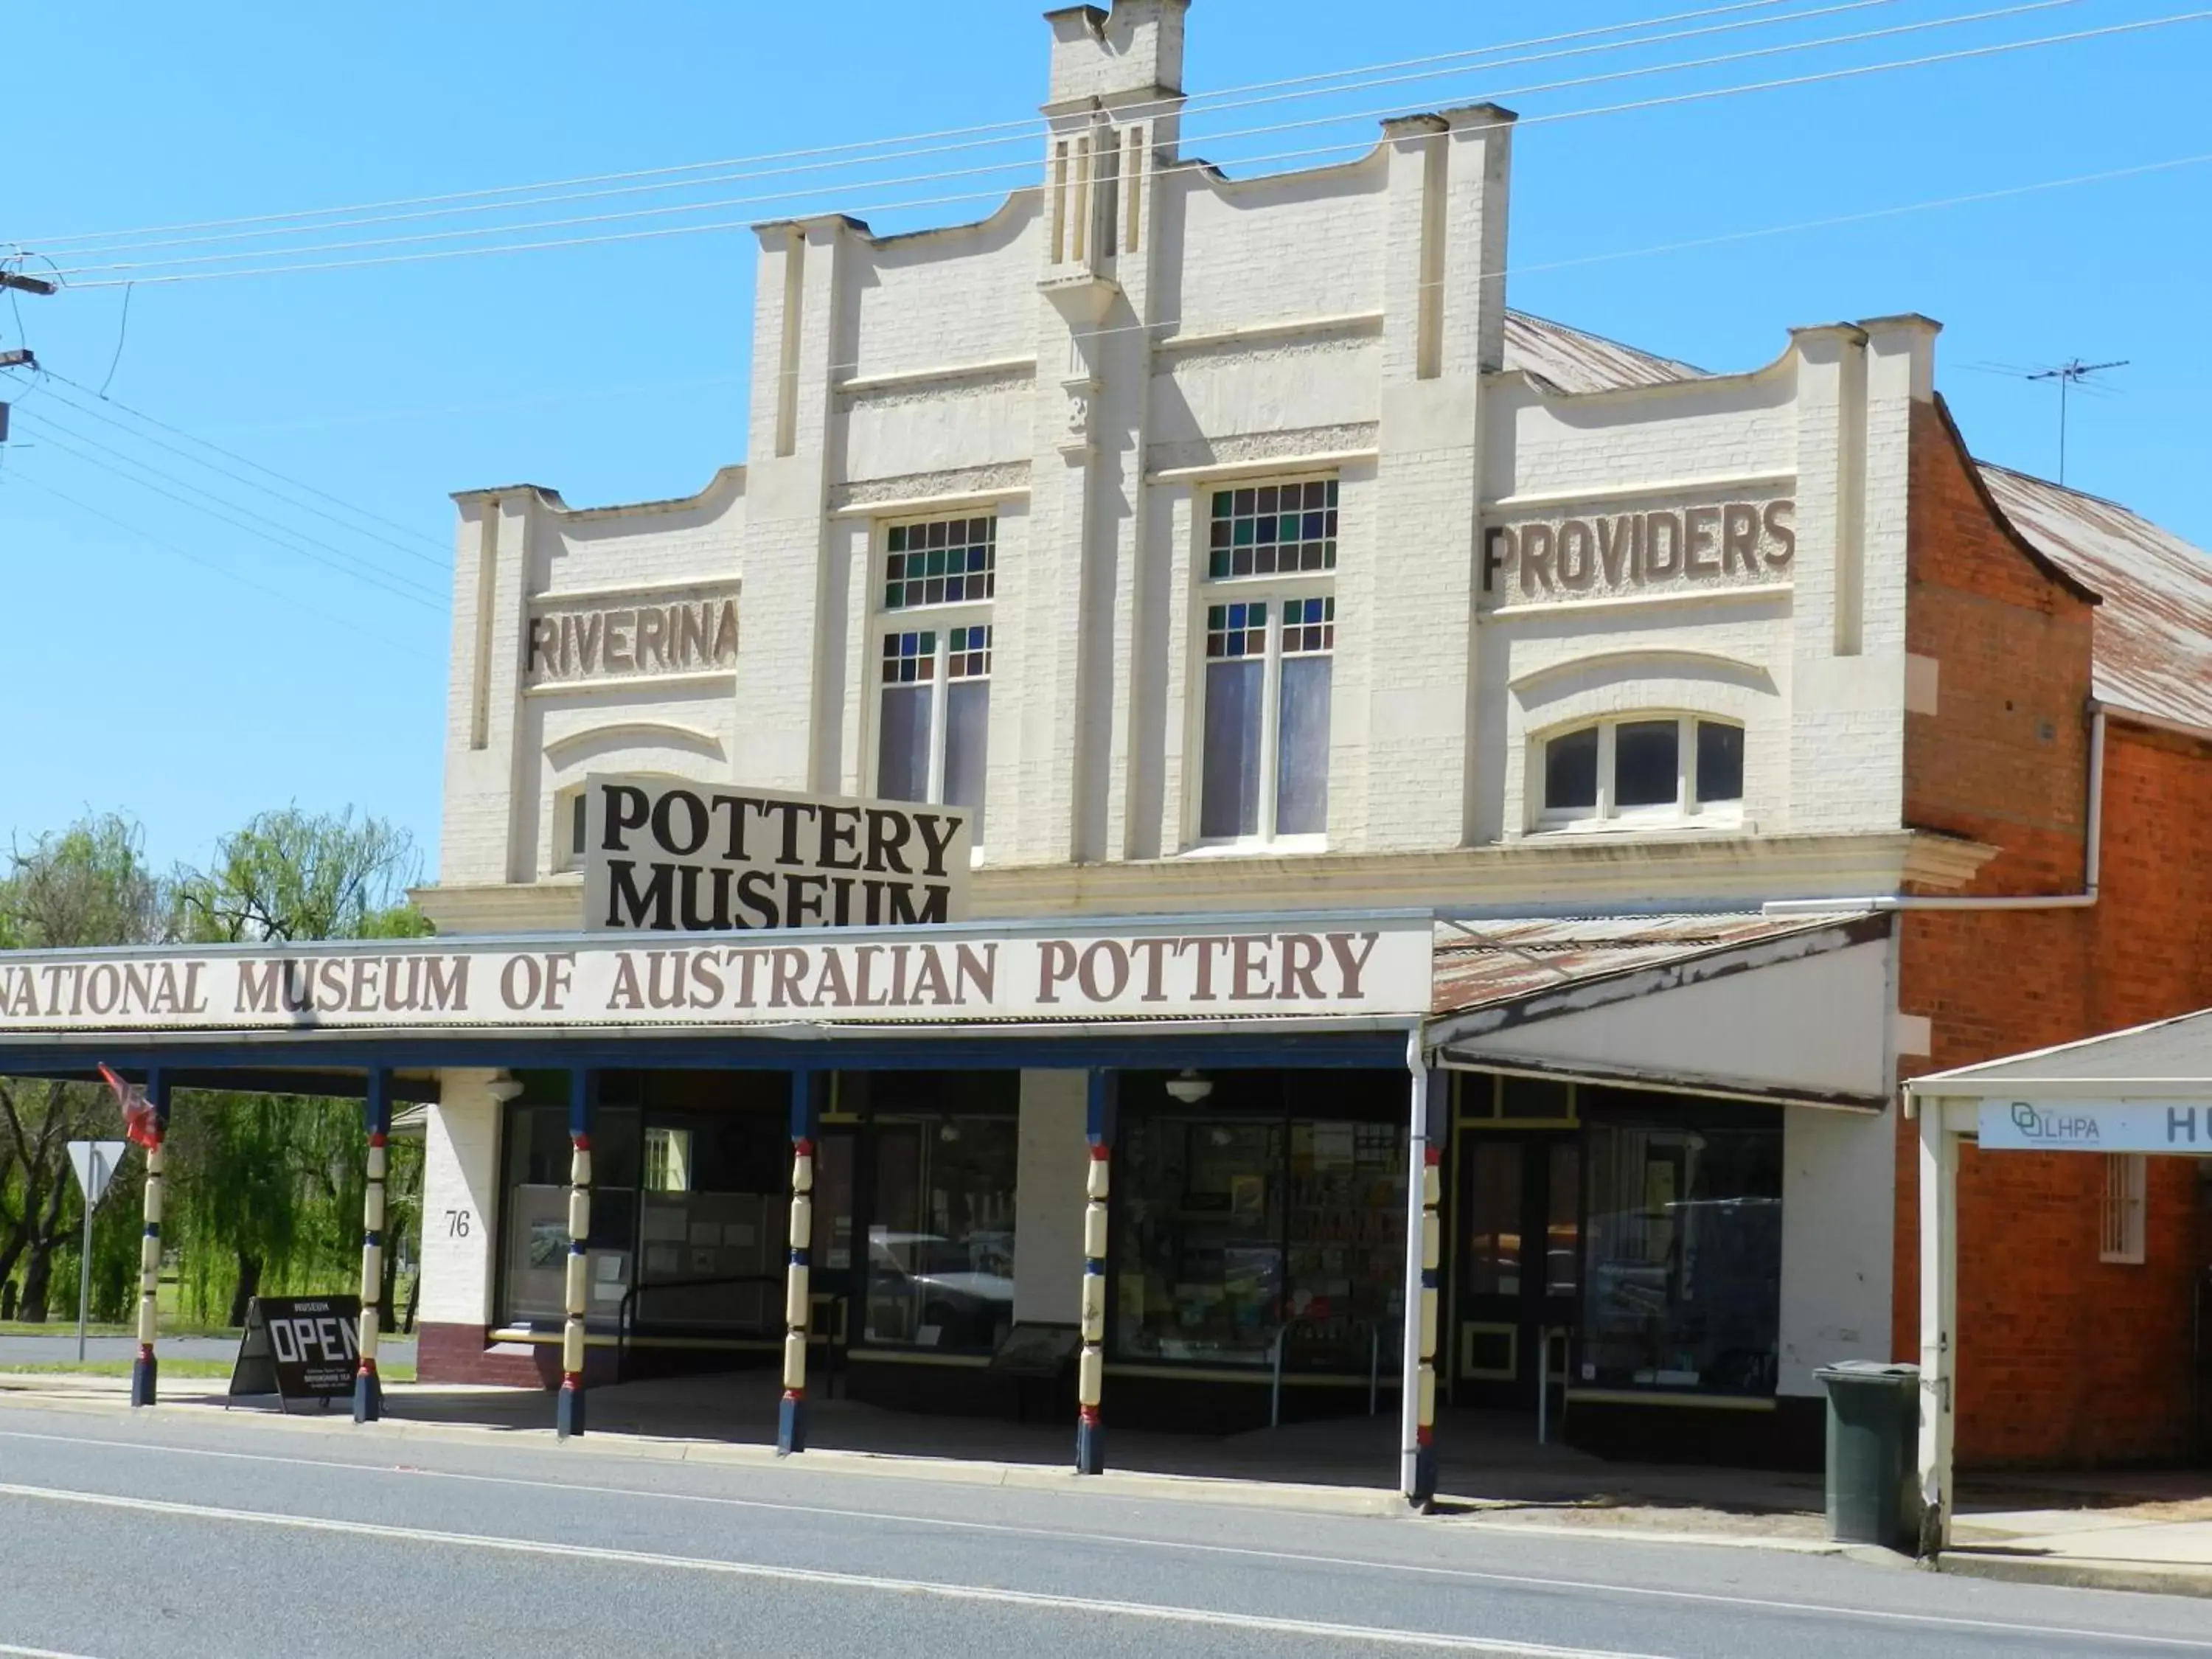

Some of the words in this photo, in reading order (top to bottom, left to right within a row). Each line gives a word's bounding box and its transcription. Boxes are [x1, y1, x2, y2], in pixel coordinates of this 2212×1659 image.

[1483, 500, 1796, 597] PROVIDERS
[528, 599, 738, 677] RIVERINA
[601, 784, 963, 877] POTTERY
[605, 859, 950, 931] MUSEUM
[234, 955, 471, 1013] MUSEUM
[500, 951, 577, 1011] OF
[606, 943, 998, 1010] AUSTRALIAN
[1035, 932, 1380, 1004] POTTERY
[2045, 1118, 2100, 1138] LHPA
[445, 1210, 470, 1238] 76
[269, 1317, 361, 1363] OPEN
[294, 1302, 330, 1312] MUSEUM
